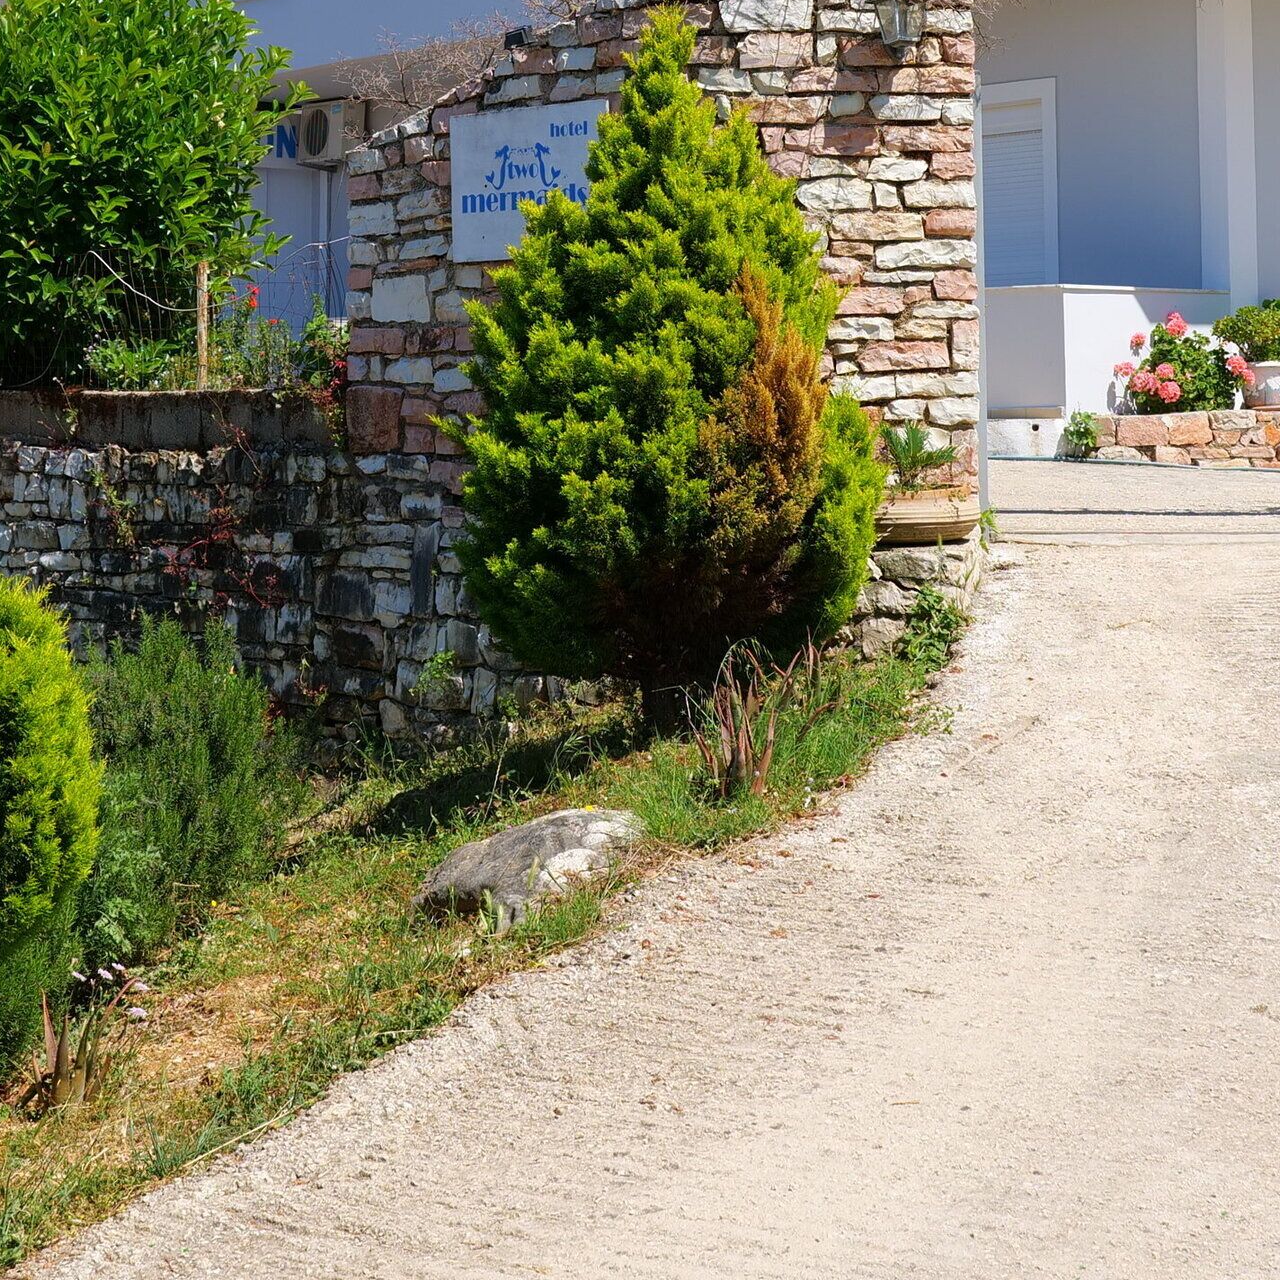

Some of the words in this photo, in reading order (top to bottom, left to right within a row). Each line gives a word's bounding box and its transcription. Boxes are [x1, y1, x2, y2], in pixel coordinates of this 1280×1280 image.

[549, 120, 588, 138] hotel
[507, 161, 539, 180] two
[462, 183, 588, 214] mermads
